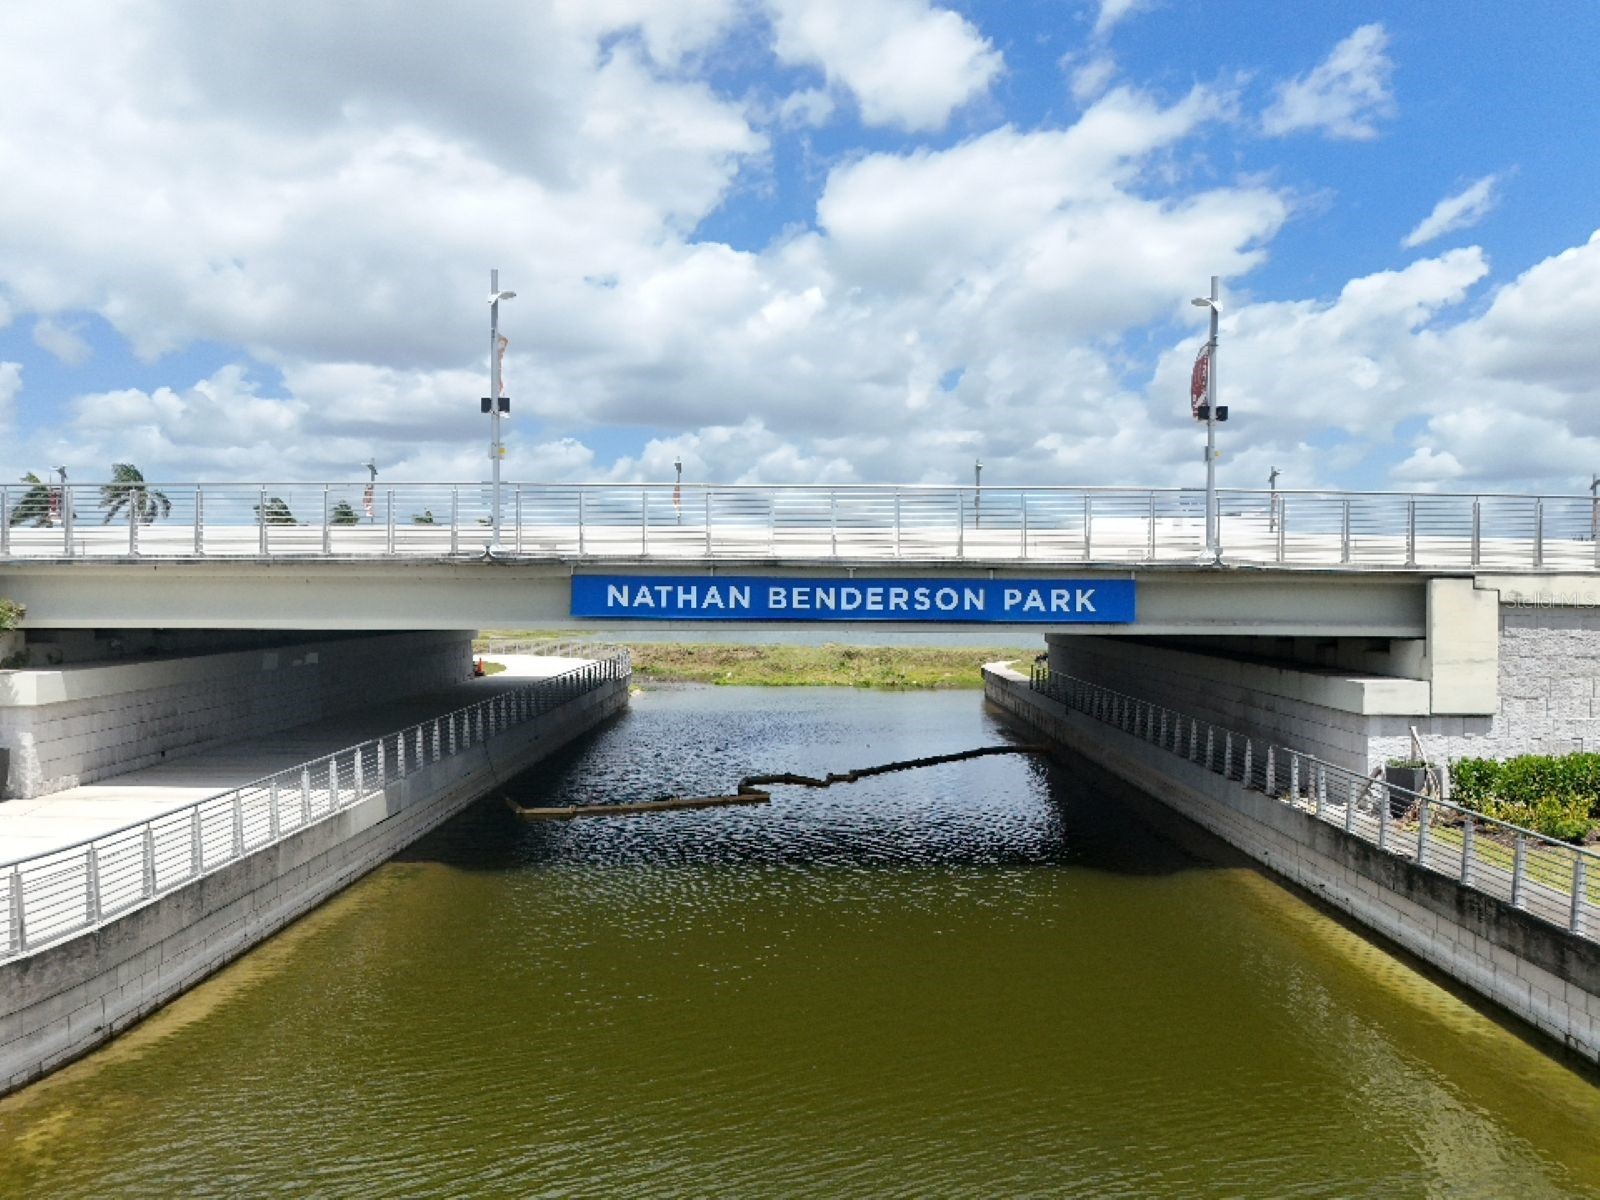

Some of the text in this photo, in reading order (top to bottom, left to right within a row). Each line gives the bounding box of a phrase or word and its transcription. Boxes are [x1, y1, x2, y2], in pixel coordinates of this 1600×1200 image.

[606, 585, 1096, 613] NATHAN BENDERSON PARK
